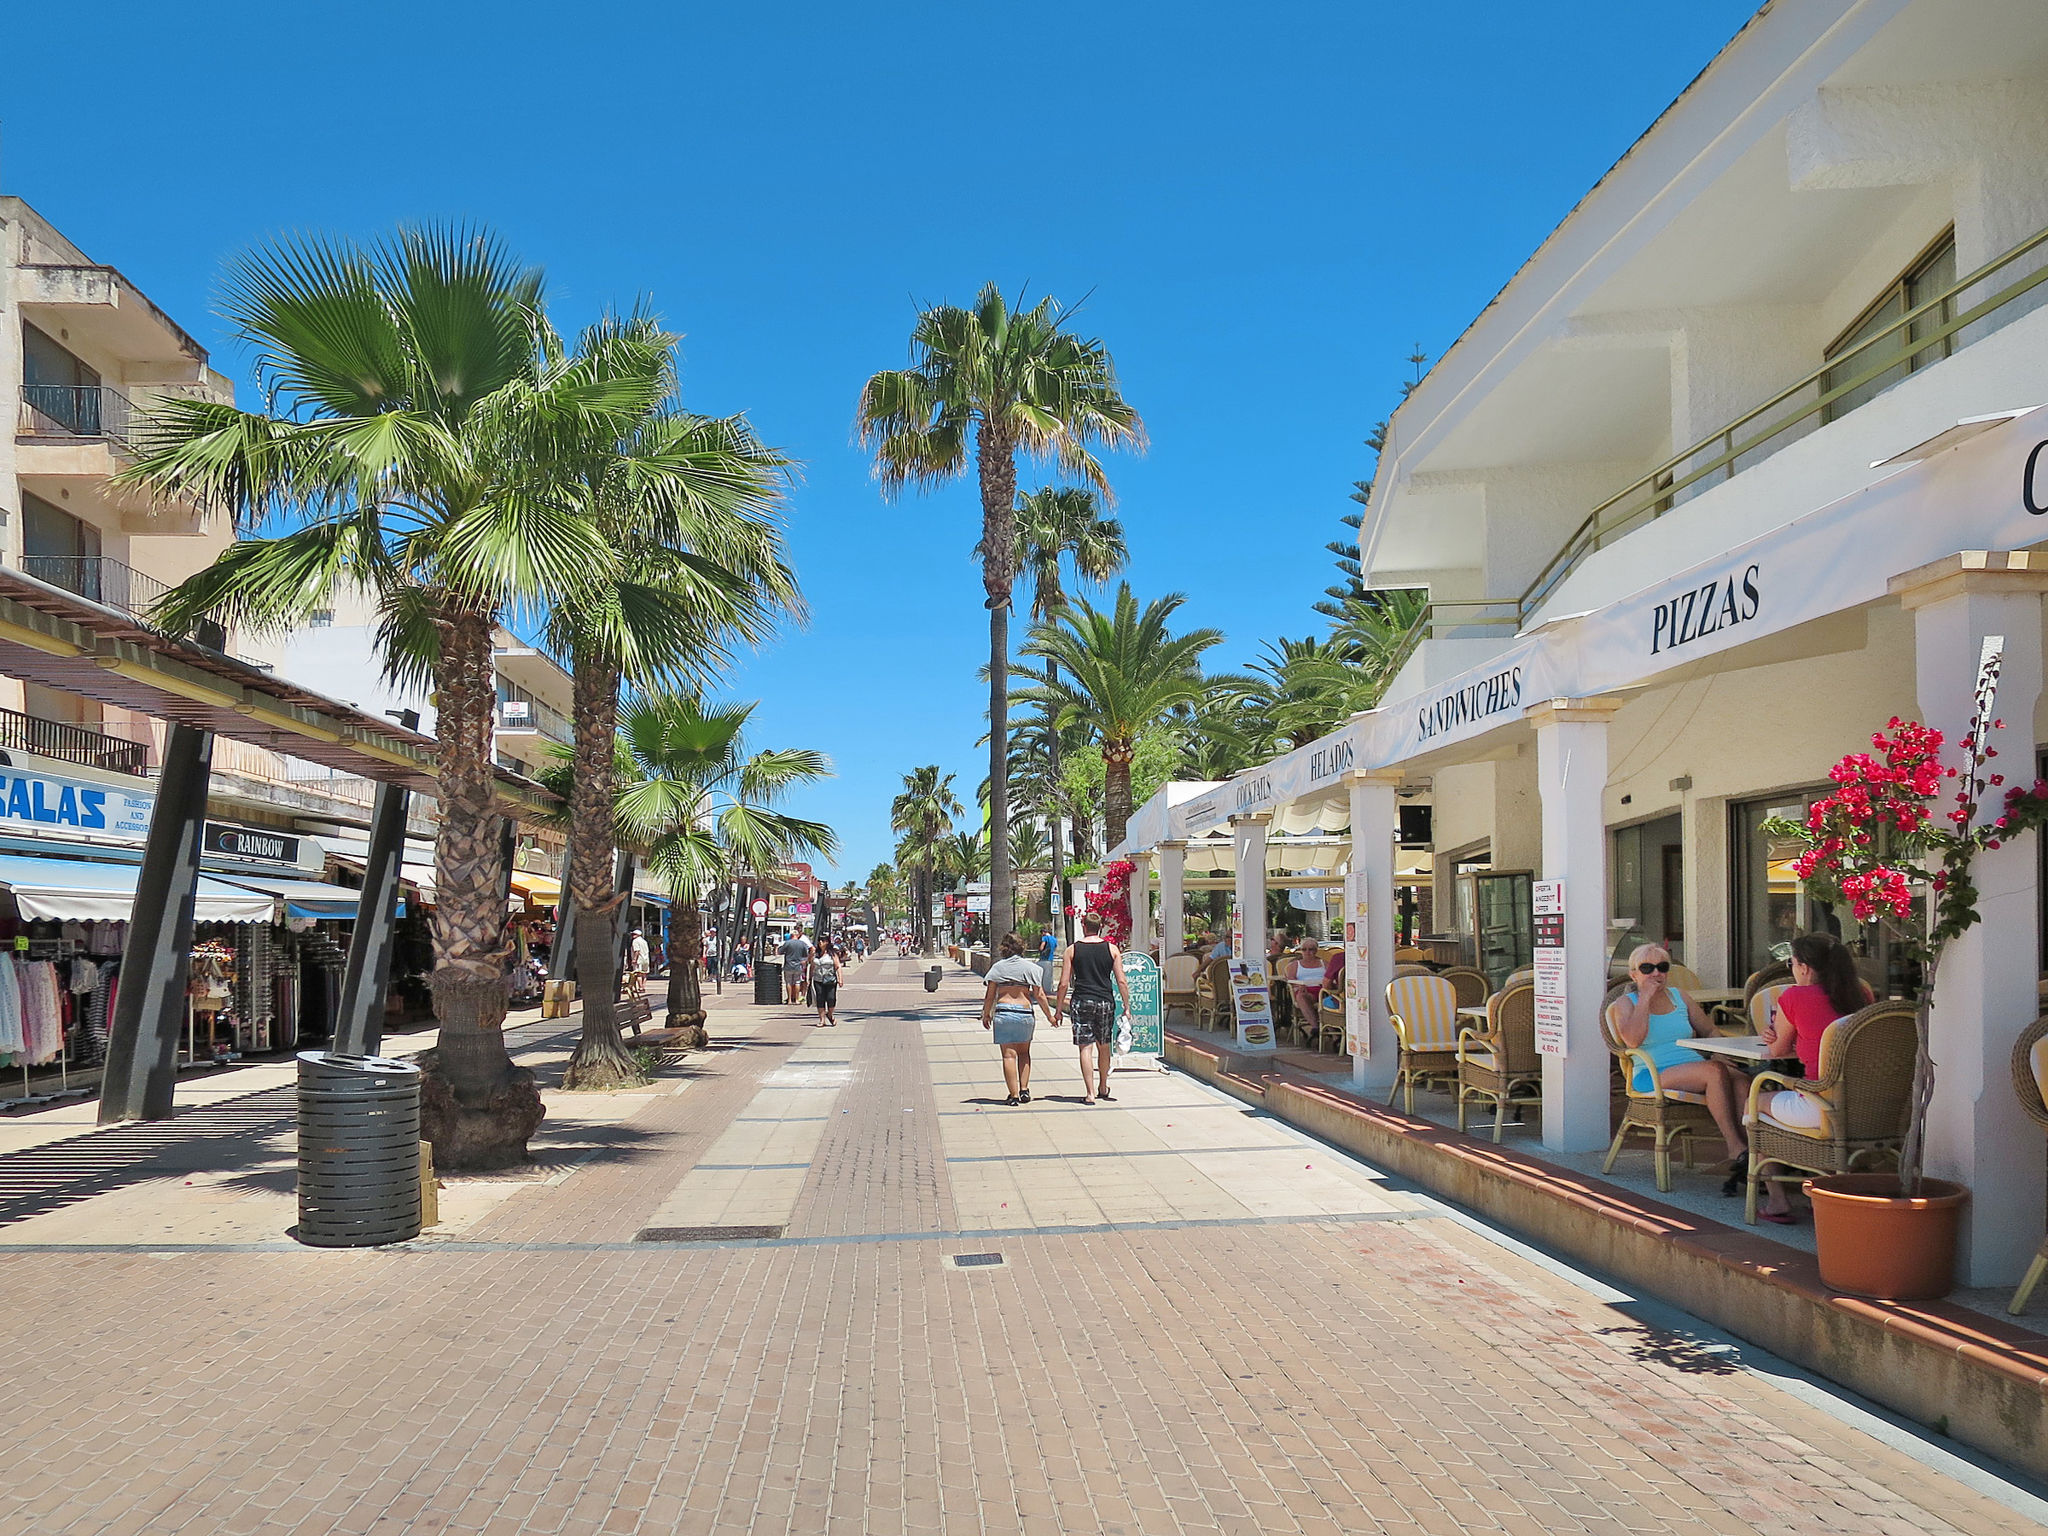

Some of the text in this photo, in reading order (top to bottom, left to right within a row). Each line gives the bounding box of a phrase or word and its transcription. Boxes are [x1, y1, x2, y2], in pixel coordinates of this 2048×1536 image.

[1650, 563, 1760, 655] PIZZAS
[1418, 667, 1522, 742] SANDWICHES
[1311, 738, 1354, 782] HELADOS
[130, 812, 145, 821] AND
[237, 833, 284, 858] RAINBOW
